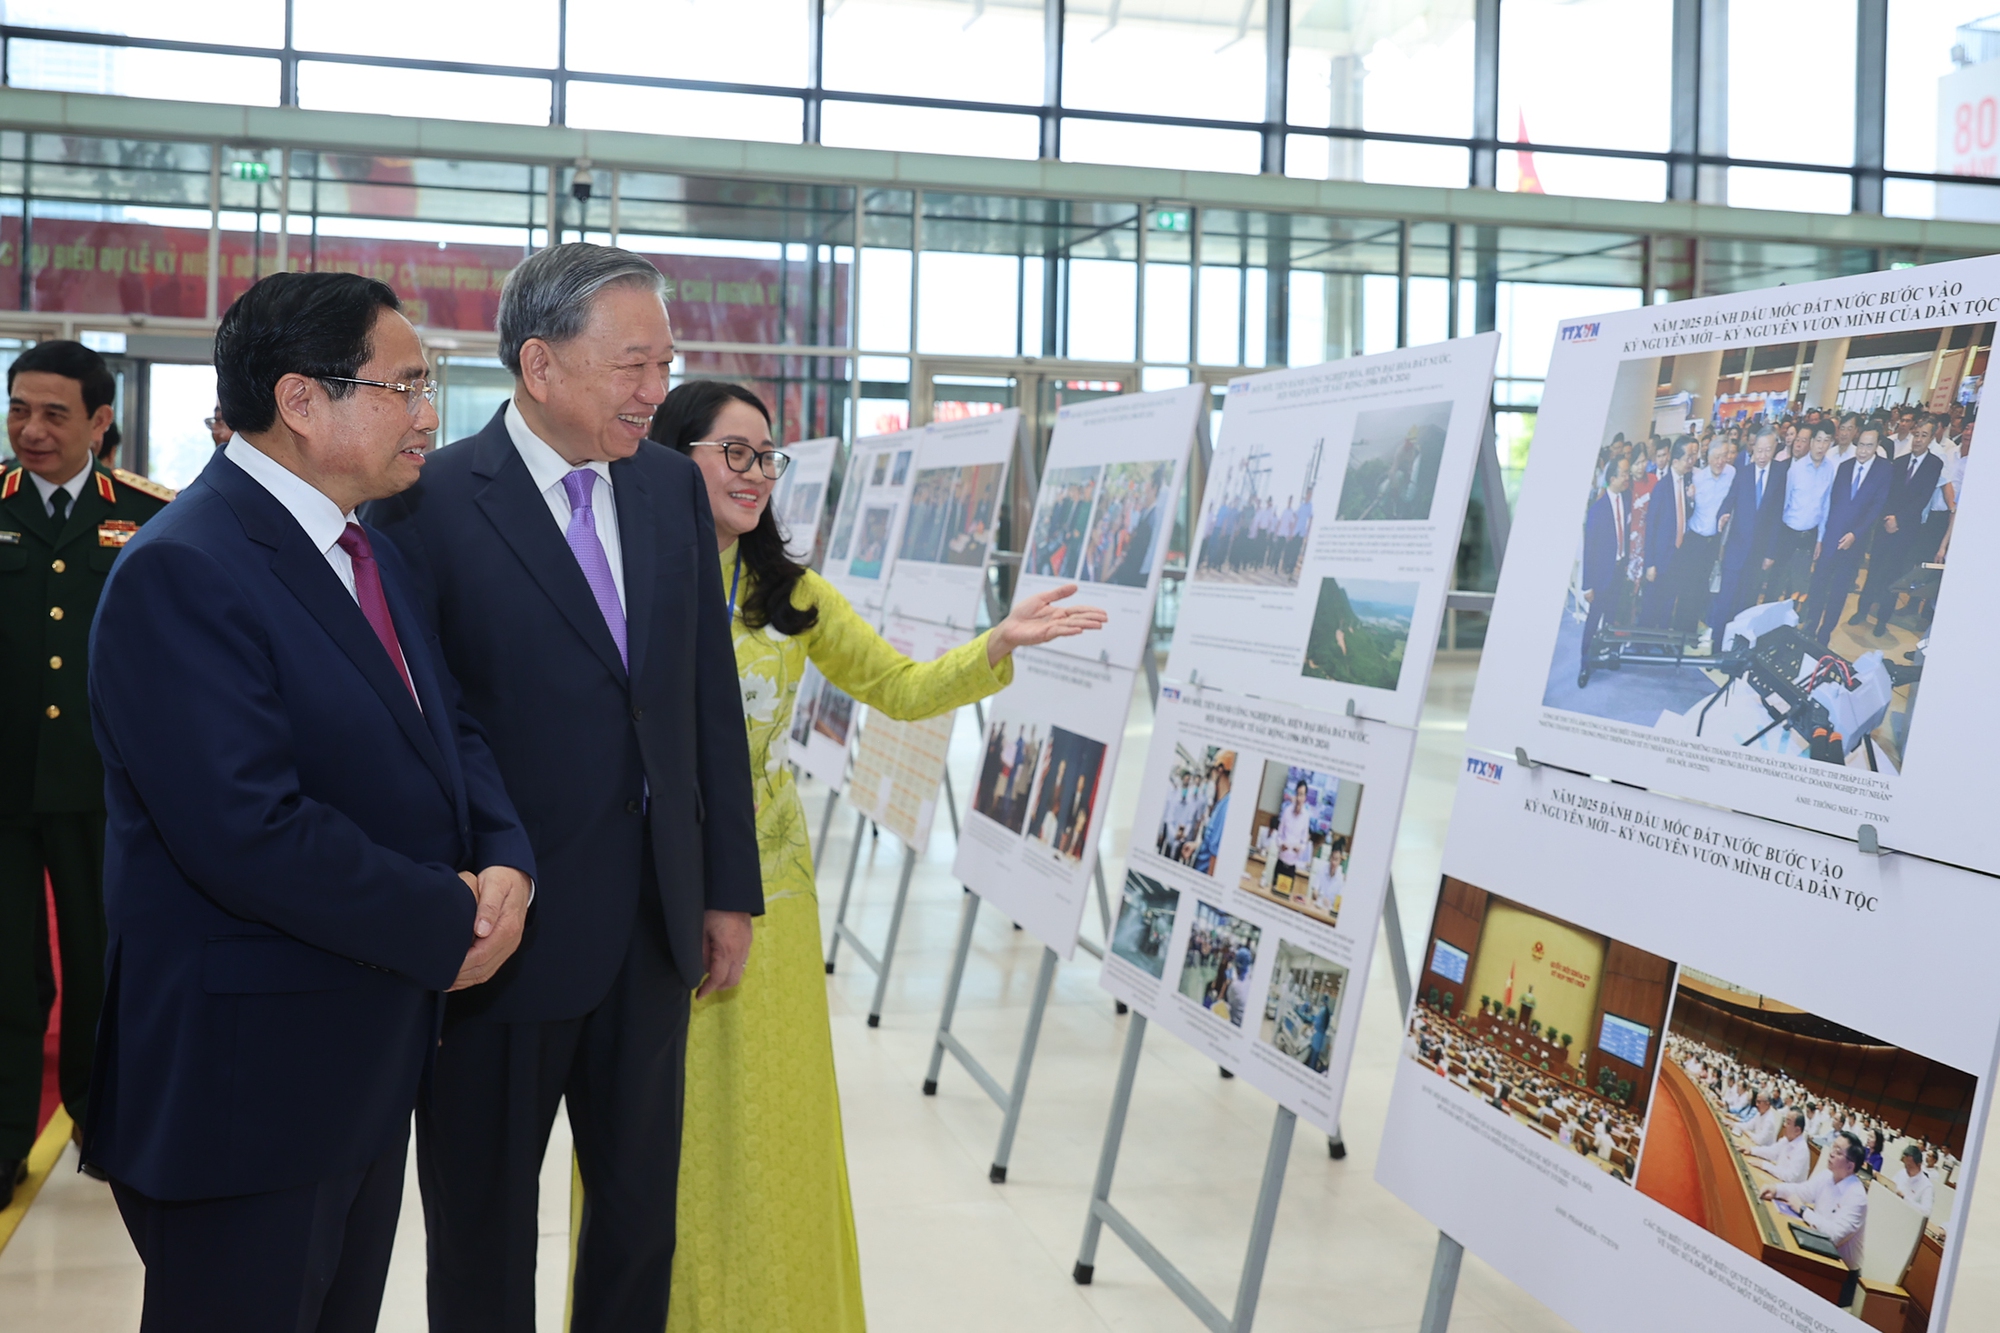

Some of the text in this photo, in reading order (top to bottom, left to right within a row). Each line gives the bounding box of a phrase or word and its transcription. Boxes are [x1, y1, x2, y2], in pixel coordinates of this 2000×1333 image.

[1954, 97, 1998, 155] 80
[1640, 331, 1687, 350] NGUYÊN
[1689, 328, 1713, 345] MỚI
[1743, 319, 1799, 338] NGUYÊN
[1803, 313, 1842, 332] VƯƠN
[1844, 309, 1886, 328] MÌNH
[1890, 304, 1921, 322] CỦA
[1925, 299, 1960, 319] DÂN
[1964, 296, 2000, 317] TỘC
[1651, 317, 1677, 334] NĂM
[1680, 316, 1701, 330] 2025
[1704, 311, 1737, 327] ĐÁNH
[1834, 289, 1877, 311] NƯỚC
[1880, 284, 1924, 305] BƯỚC
[1929, 280, 1963, 298] VÀO
[1551, 788, 1575, 807] NĂM
[1577, 796, 1598, 813] 2025
[1600, 800, 1632, 822] ĐÁNH
[1723, 832, 1763, 858] NƯỚC
[1765, 845, 1808, 870] BƯỚC
[1811, 856, 1844, 880] VÀO
[1864, 810, 1890, 824] TTXVN
[1540, 804, 1585, 826] NGUYÊN
[1586, 813, 1609, 834] MỚI
[1638, 829, 1688, 858] NGUYÊN
[1692, 845, 1729, 868] VƯƠN
[1732, 857, 1772, 882] MÌNH
[1774, 869, 1804, 892] CỦA
[1807, 879, 1841, 902] DÂN
[1844, 888, 1879, 913] TỘC
